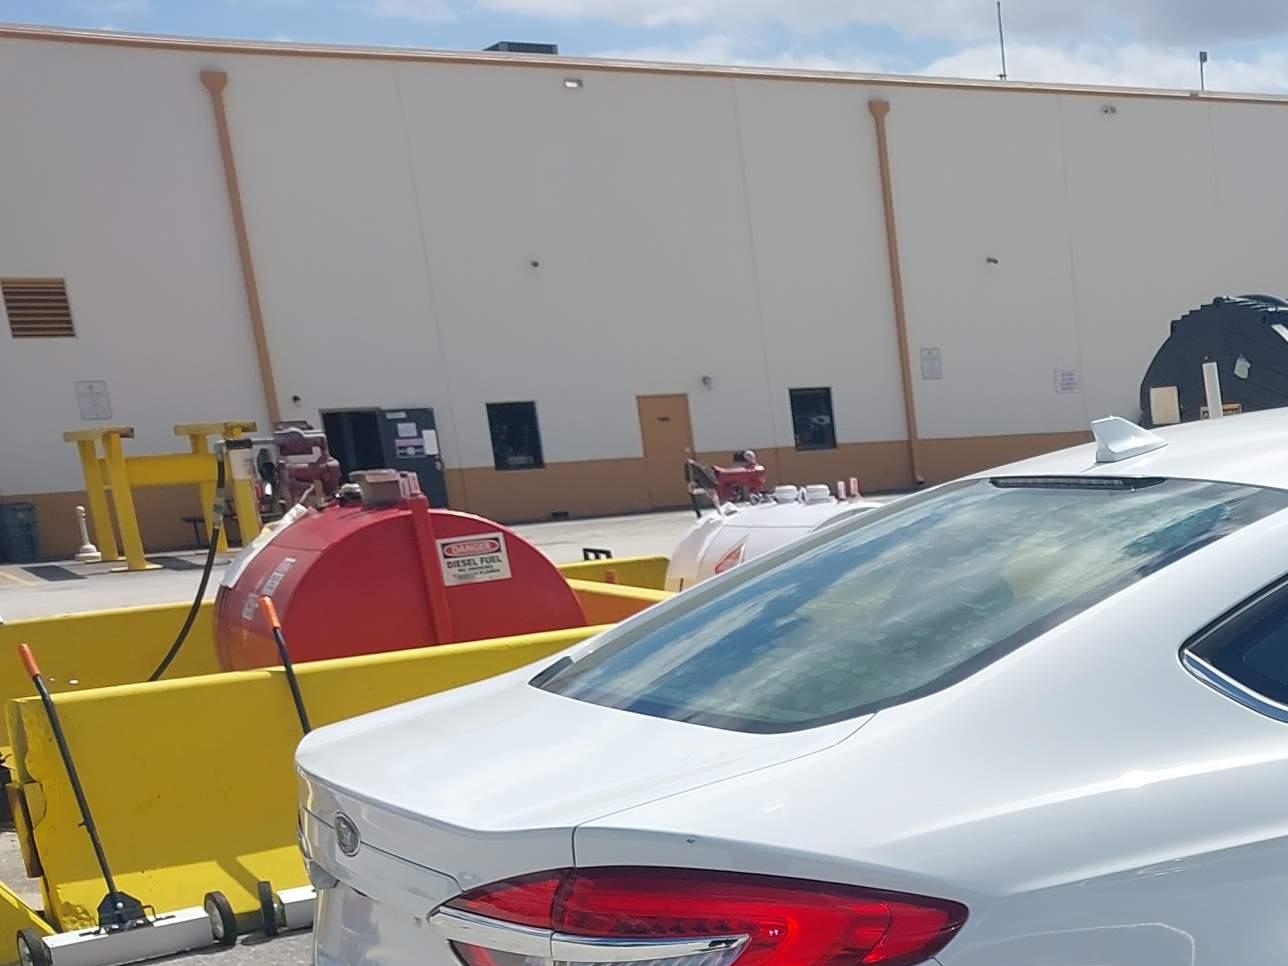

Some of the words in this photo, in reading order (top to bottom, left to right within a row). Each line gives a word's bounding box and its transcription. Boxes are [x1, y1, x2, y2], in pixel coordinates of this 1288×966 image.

[451, 541, 491, 554] DANGER
[446, 559, 478, 569] DIESEL
[480, 555, 501, 565] FUEL
